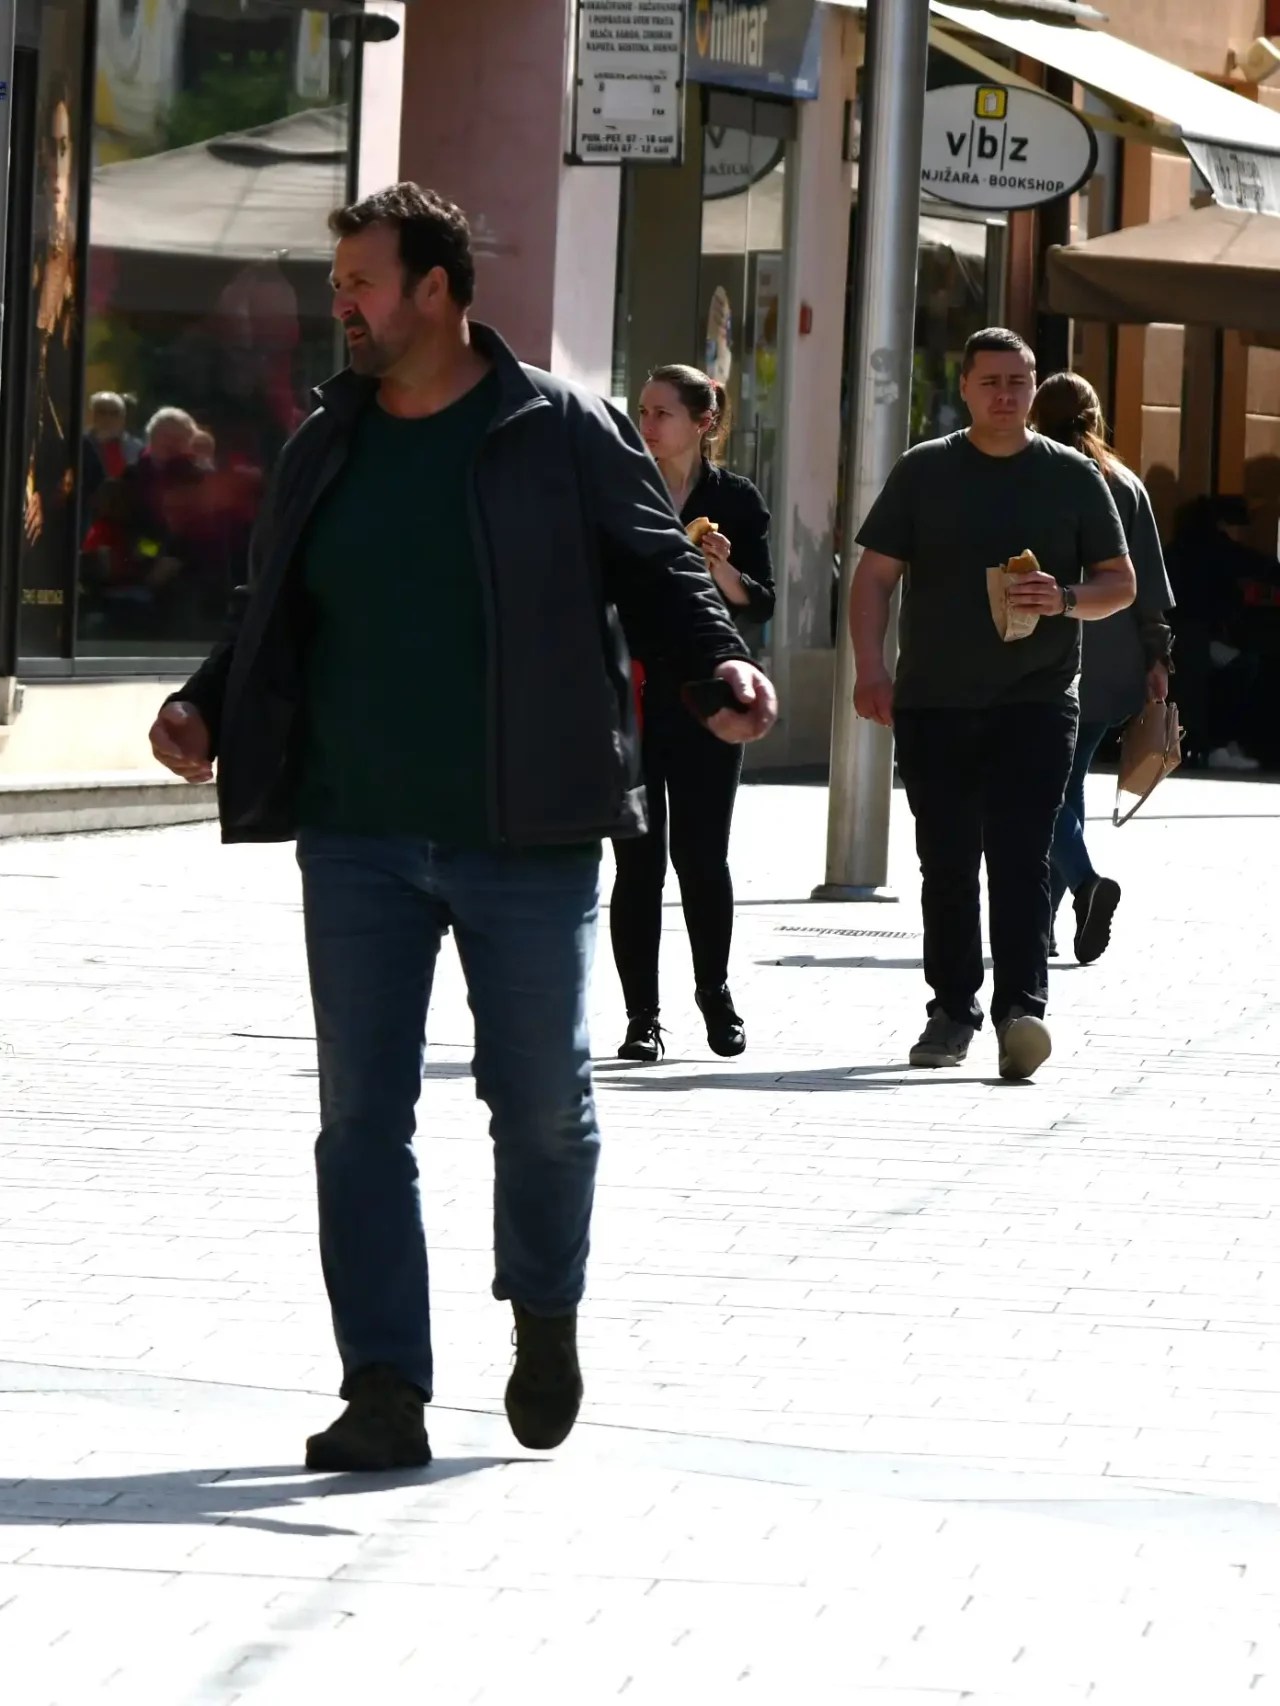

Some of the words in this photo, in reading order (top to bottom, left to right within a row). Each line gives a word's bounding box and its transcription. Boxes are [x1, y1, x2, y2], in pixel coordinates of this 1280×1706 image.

[710, 1, 767, 67] mlinar
[921, 166, 980, 185] NJIŽARA
[989, 174, 1064, 192] BOOKSHOP
